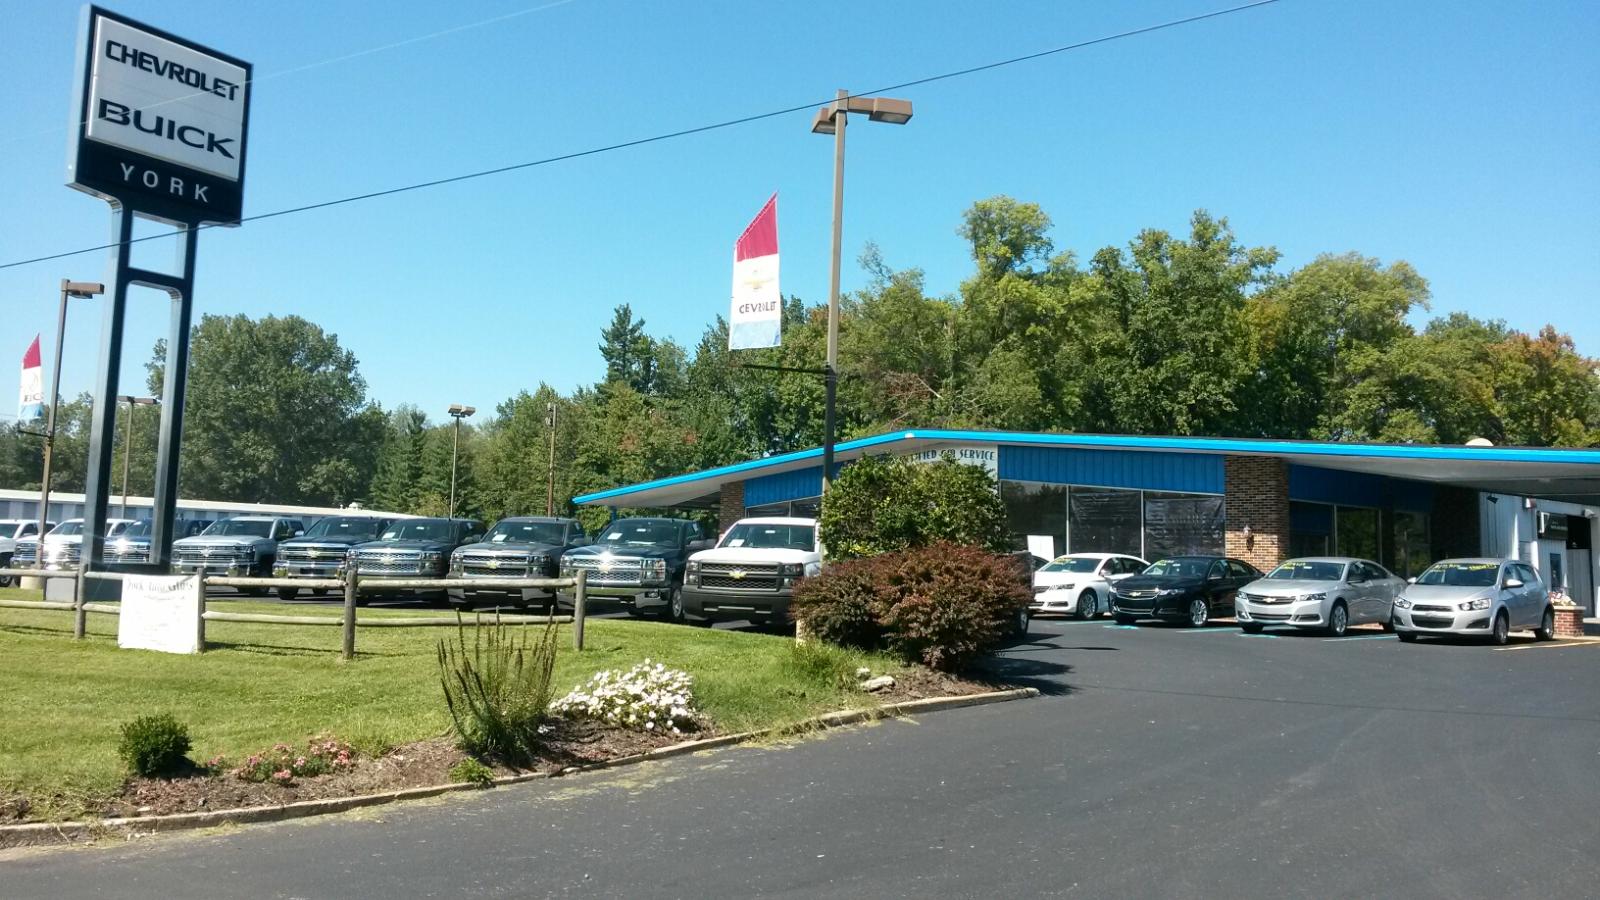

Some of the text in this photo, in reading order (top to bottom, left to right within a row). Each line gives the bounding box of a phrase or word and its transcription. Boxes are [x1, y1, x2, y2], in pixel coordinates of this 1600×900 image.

[105, 39, 239, 101] CHEVROLET
[98, 98, 235, 160] BUICK
[120, 162, 209, 203] YORK
[960, 448, 996, 461] SERVICE
